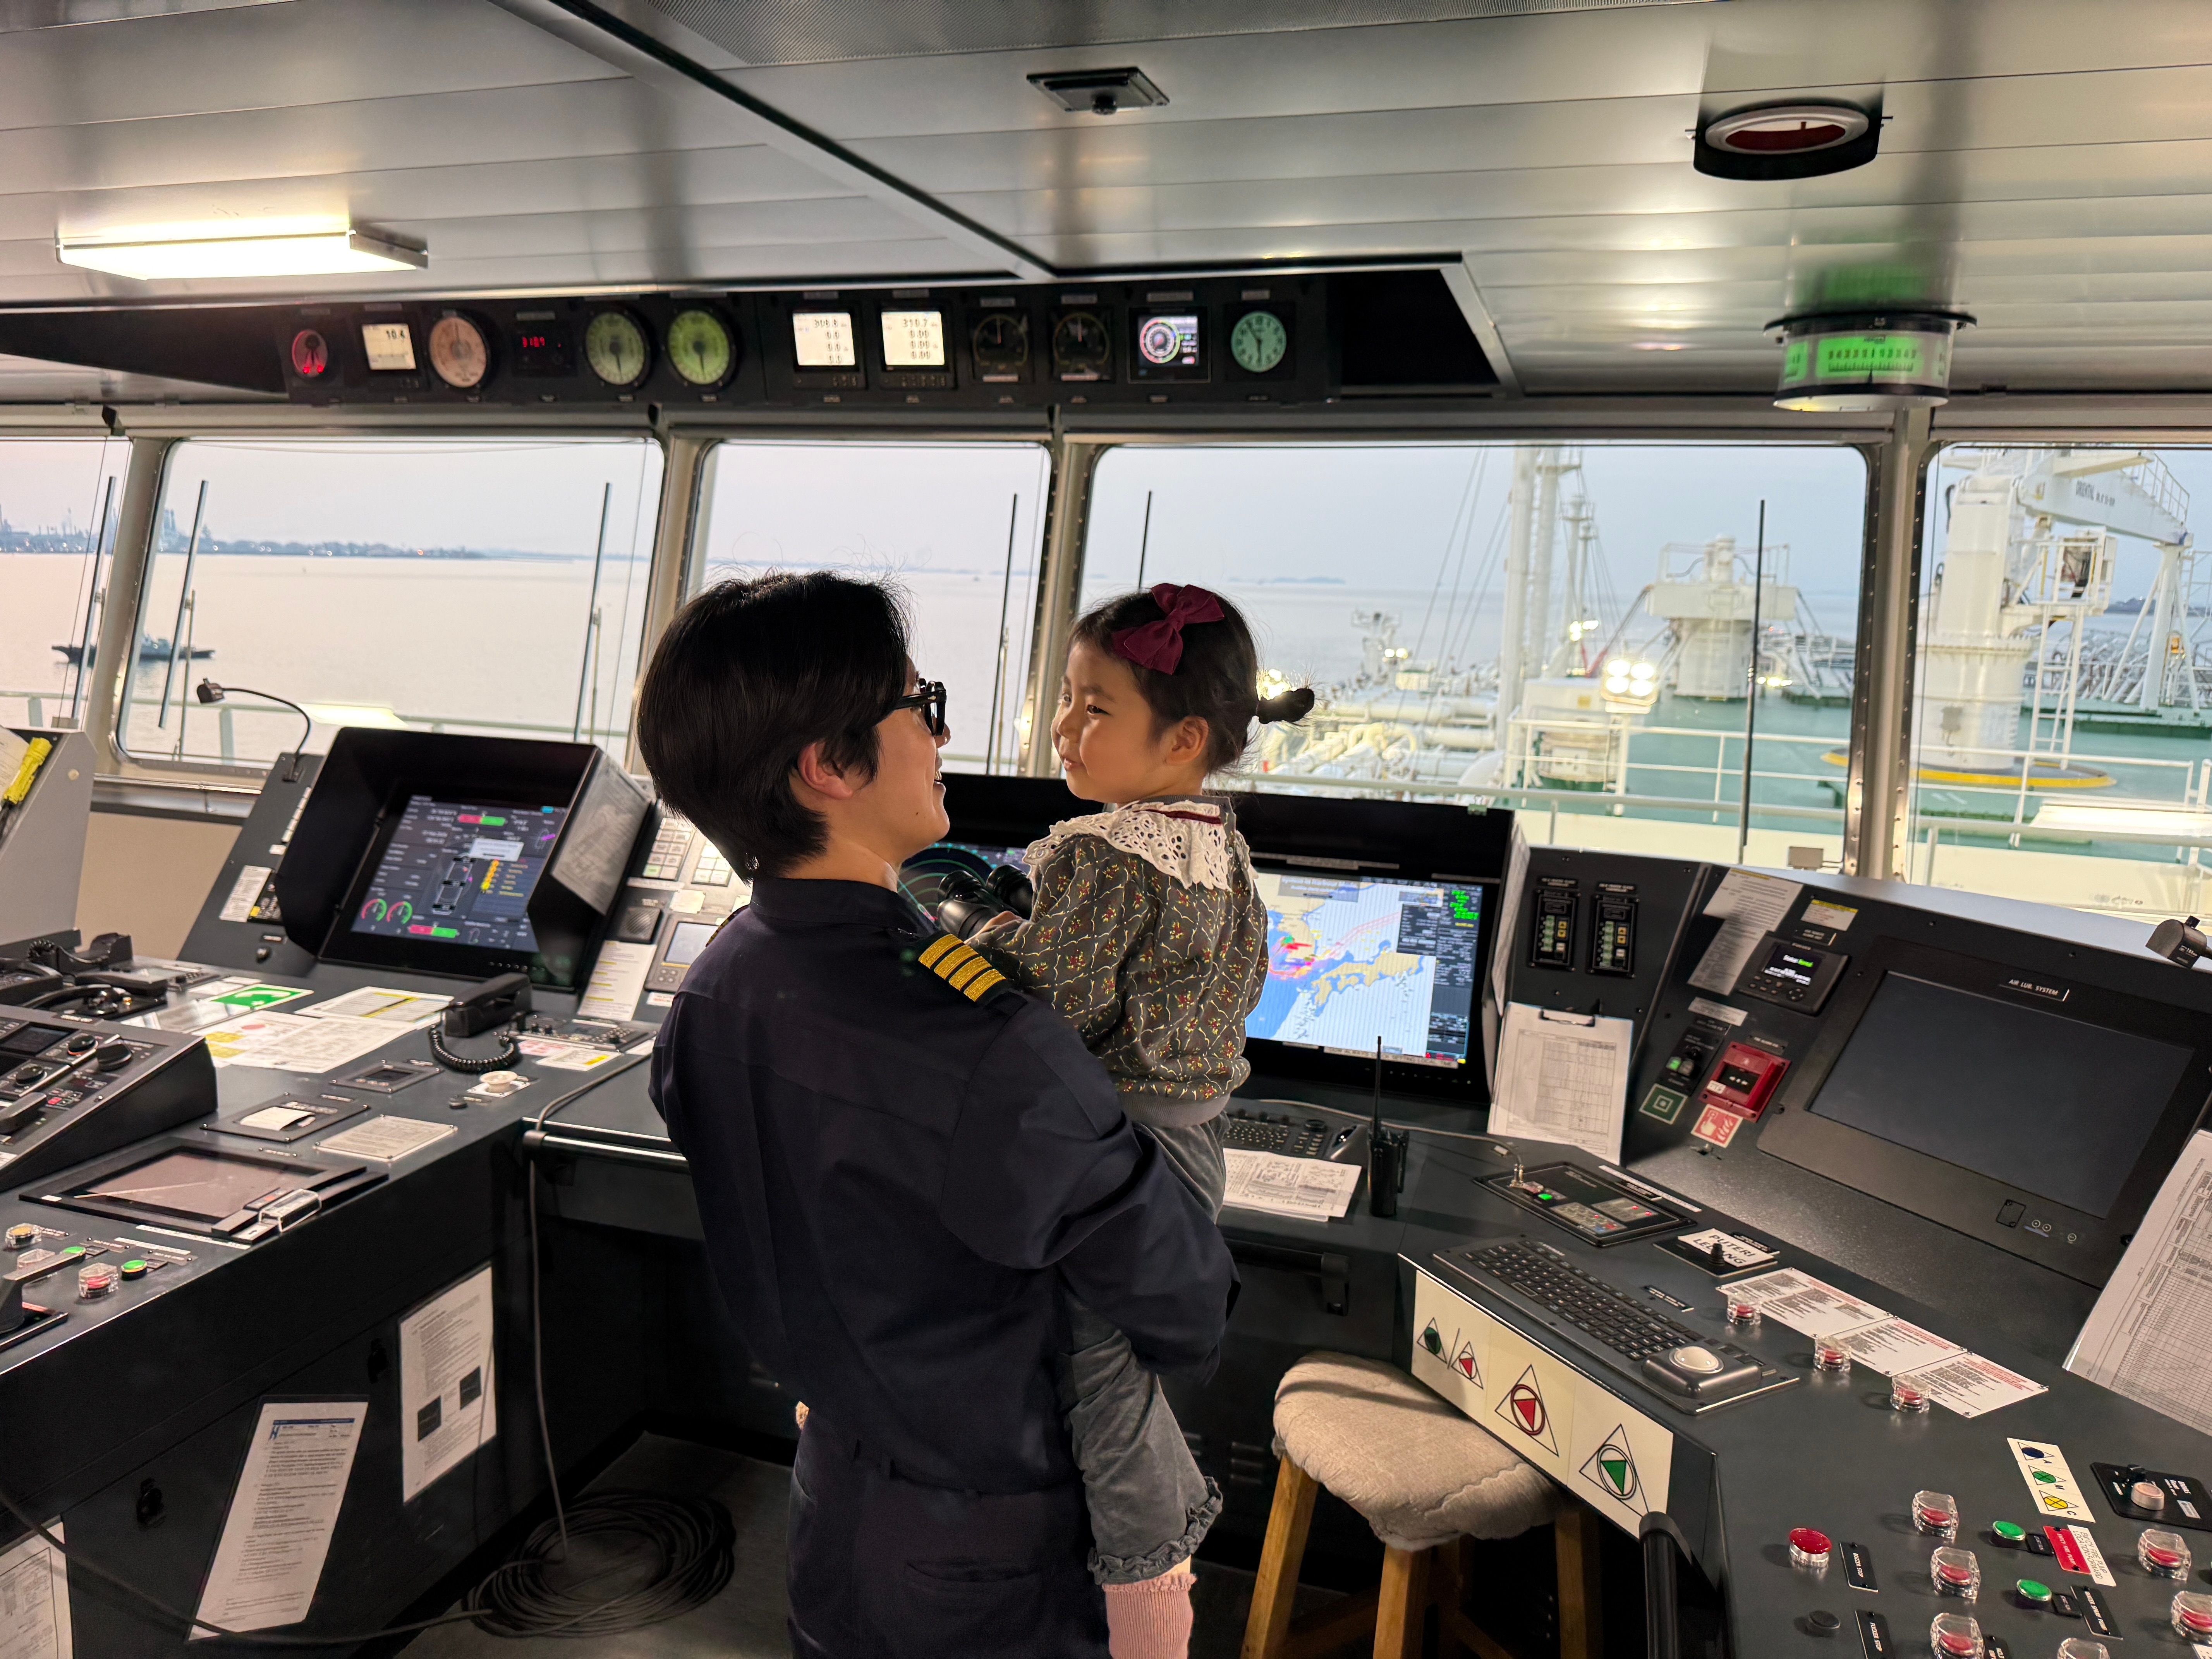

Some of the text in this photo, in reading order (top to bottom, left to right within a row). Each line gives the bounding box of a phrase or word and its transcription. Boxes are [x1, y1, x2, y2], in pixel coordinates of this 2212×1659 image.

[2035, 986, 2059, 996] SYSTEM
[1709, 1235, 1756, 1257] PUTERI
[2095, 1560, 2107, 1574] PUMP
